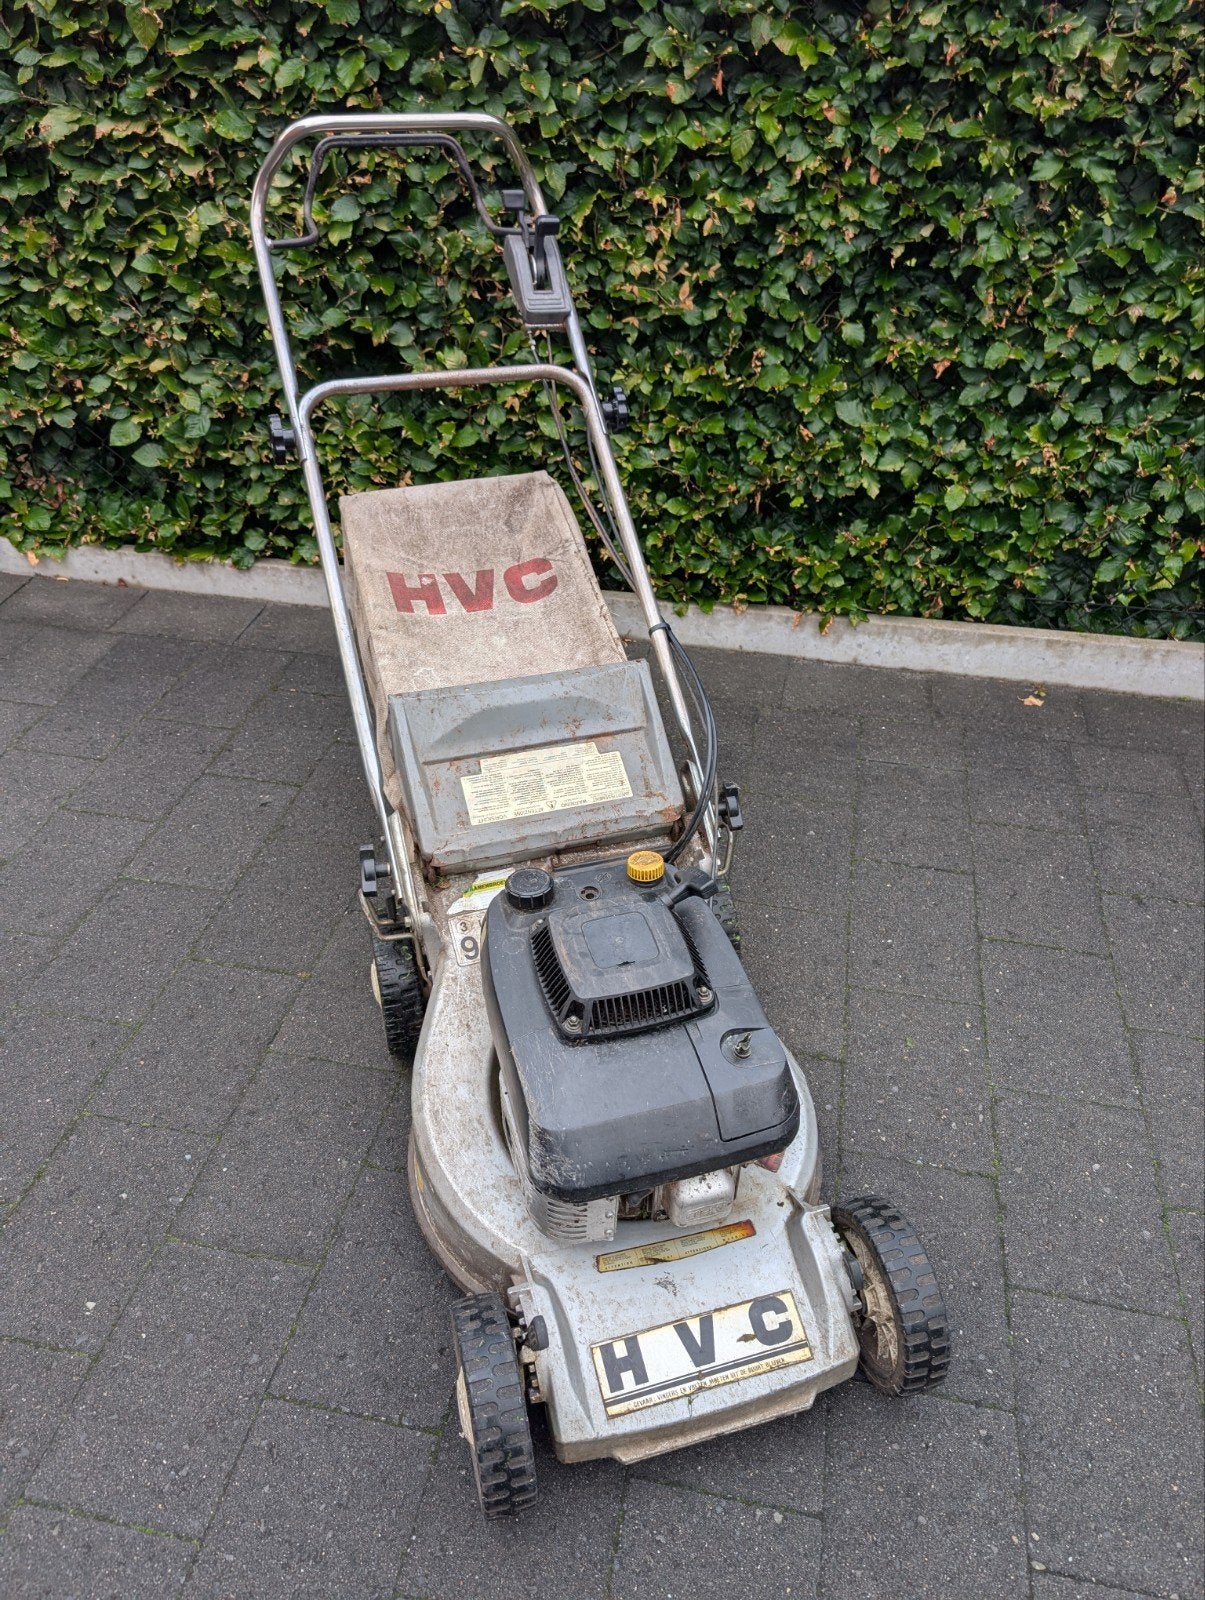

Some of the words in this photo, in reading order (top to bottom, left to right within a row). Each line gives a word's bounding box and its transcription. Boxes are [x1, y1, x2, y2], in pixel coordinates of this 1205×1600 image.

[386, 558, 558, 615] HVC
[459, 921, 468, 932] 3
[460, 936, 479, 960] 9
